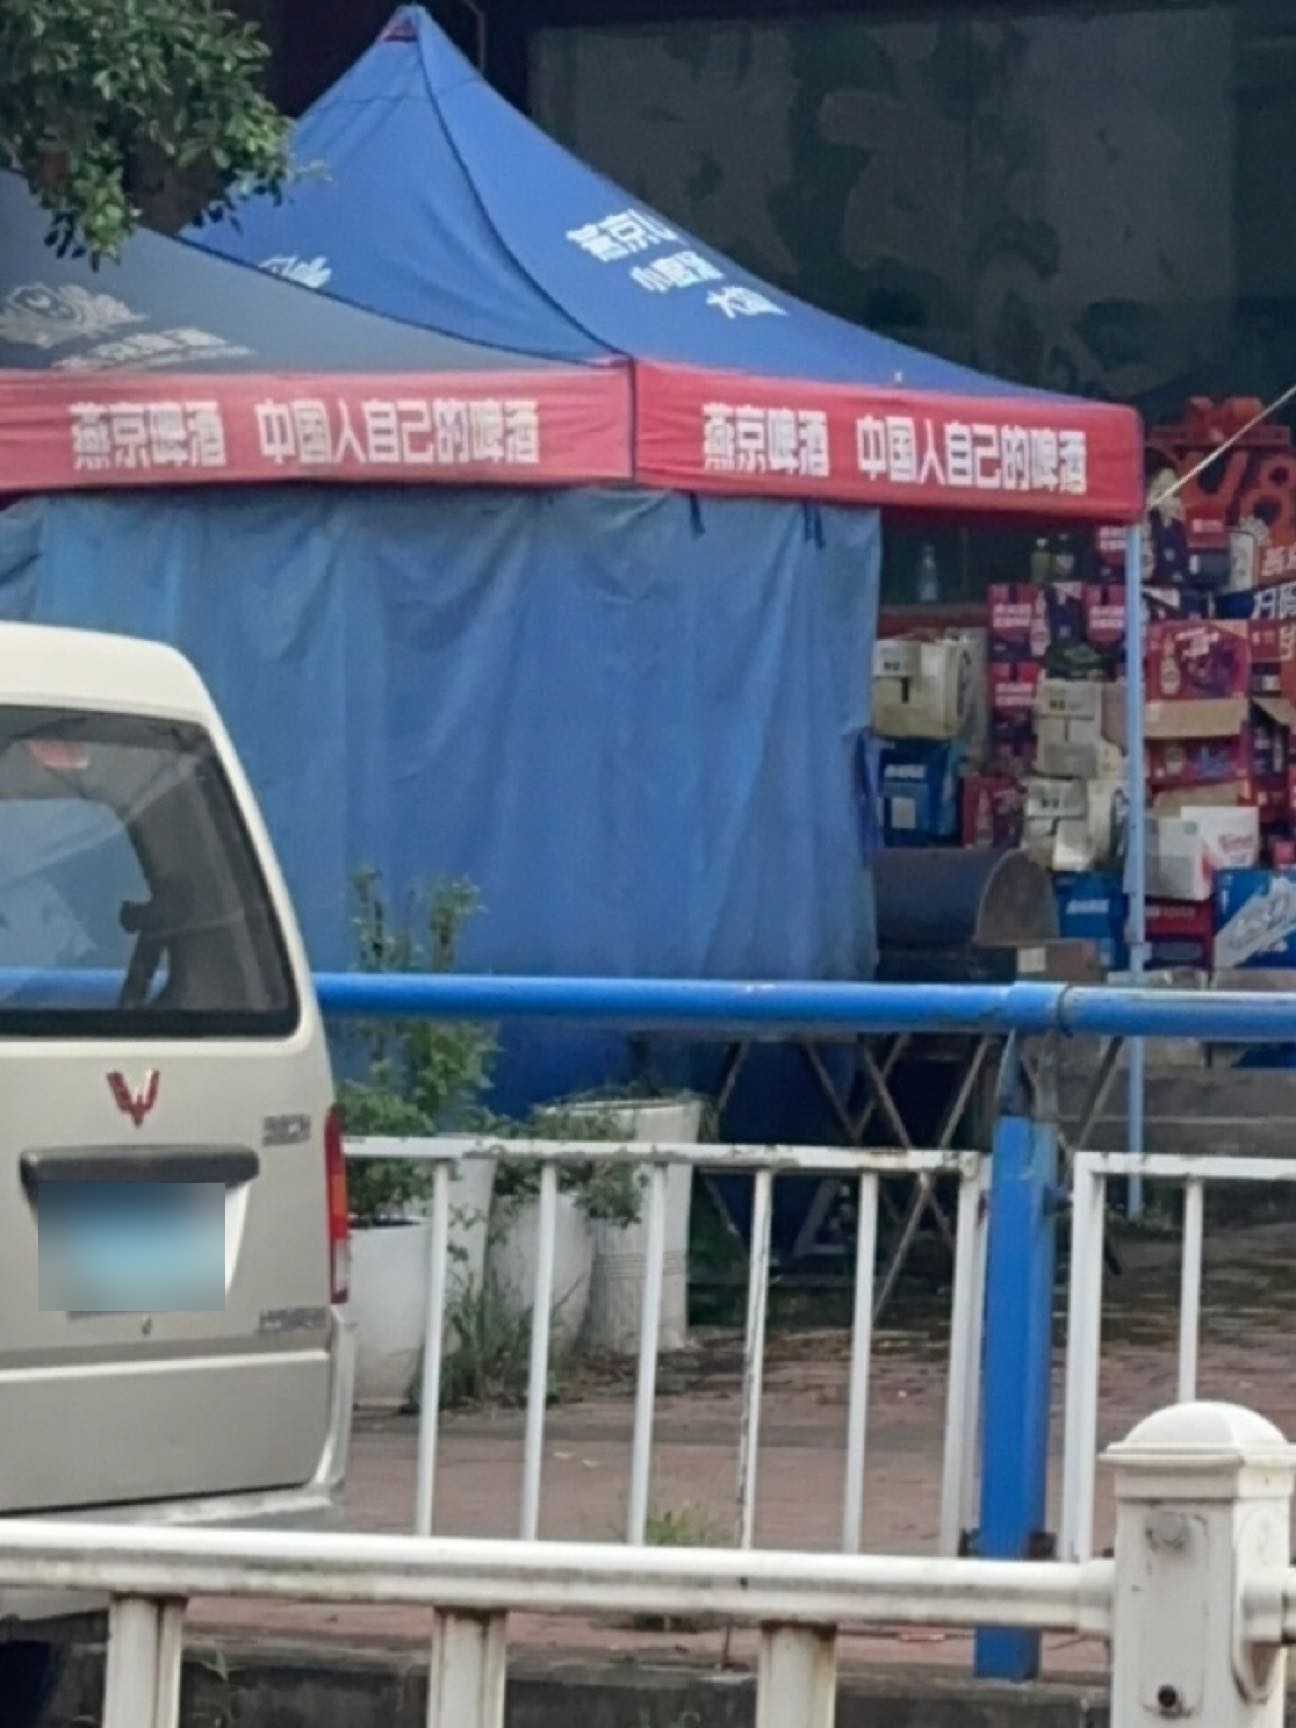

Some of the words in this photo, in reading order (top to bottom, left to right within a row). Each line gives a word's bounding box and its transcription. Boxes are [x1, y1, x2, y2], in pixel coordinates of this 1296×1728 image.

[69, 401, 226, 470] 燕京啤酒
[255, 399, 539, 465] 中国人自己的啤酒
[702, 402, 829, 477] 燕京啤酒
[856, 414, 1087, 495] 中国人自己的啤酒
